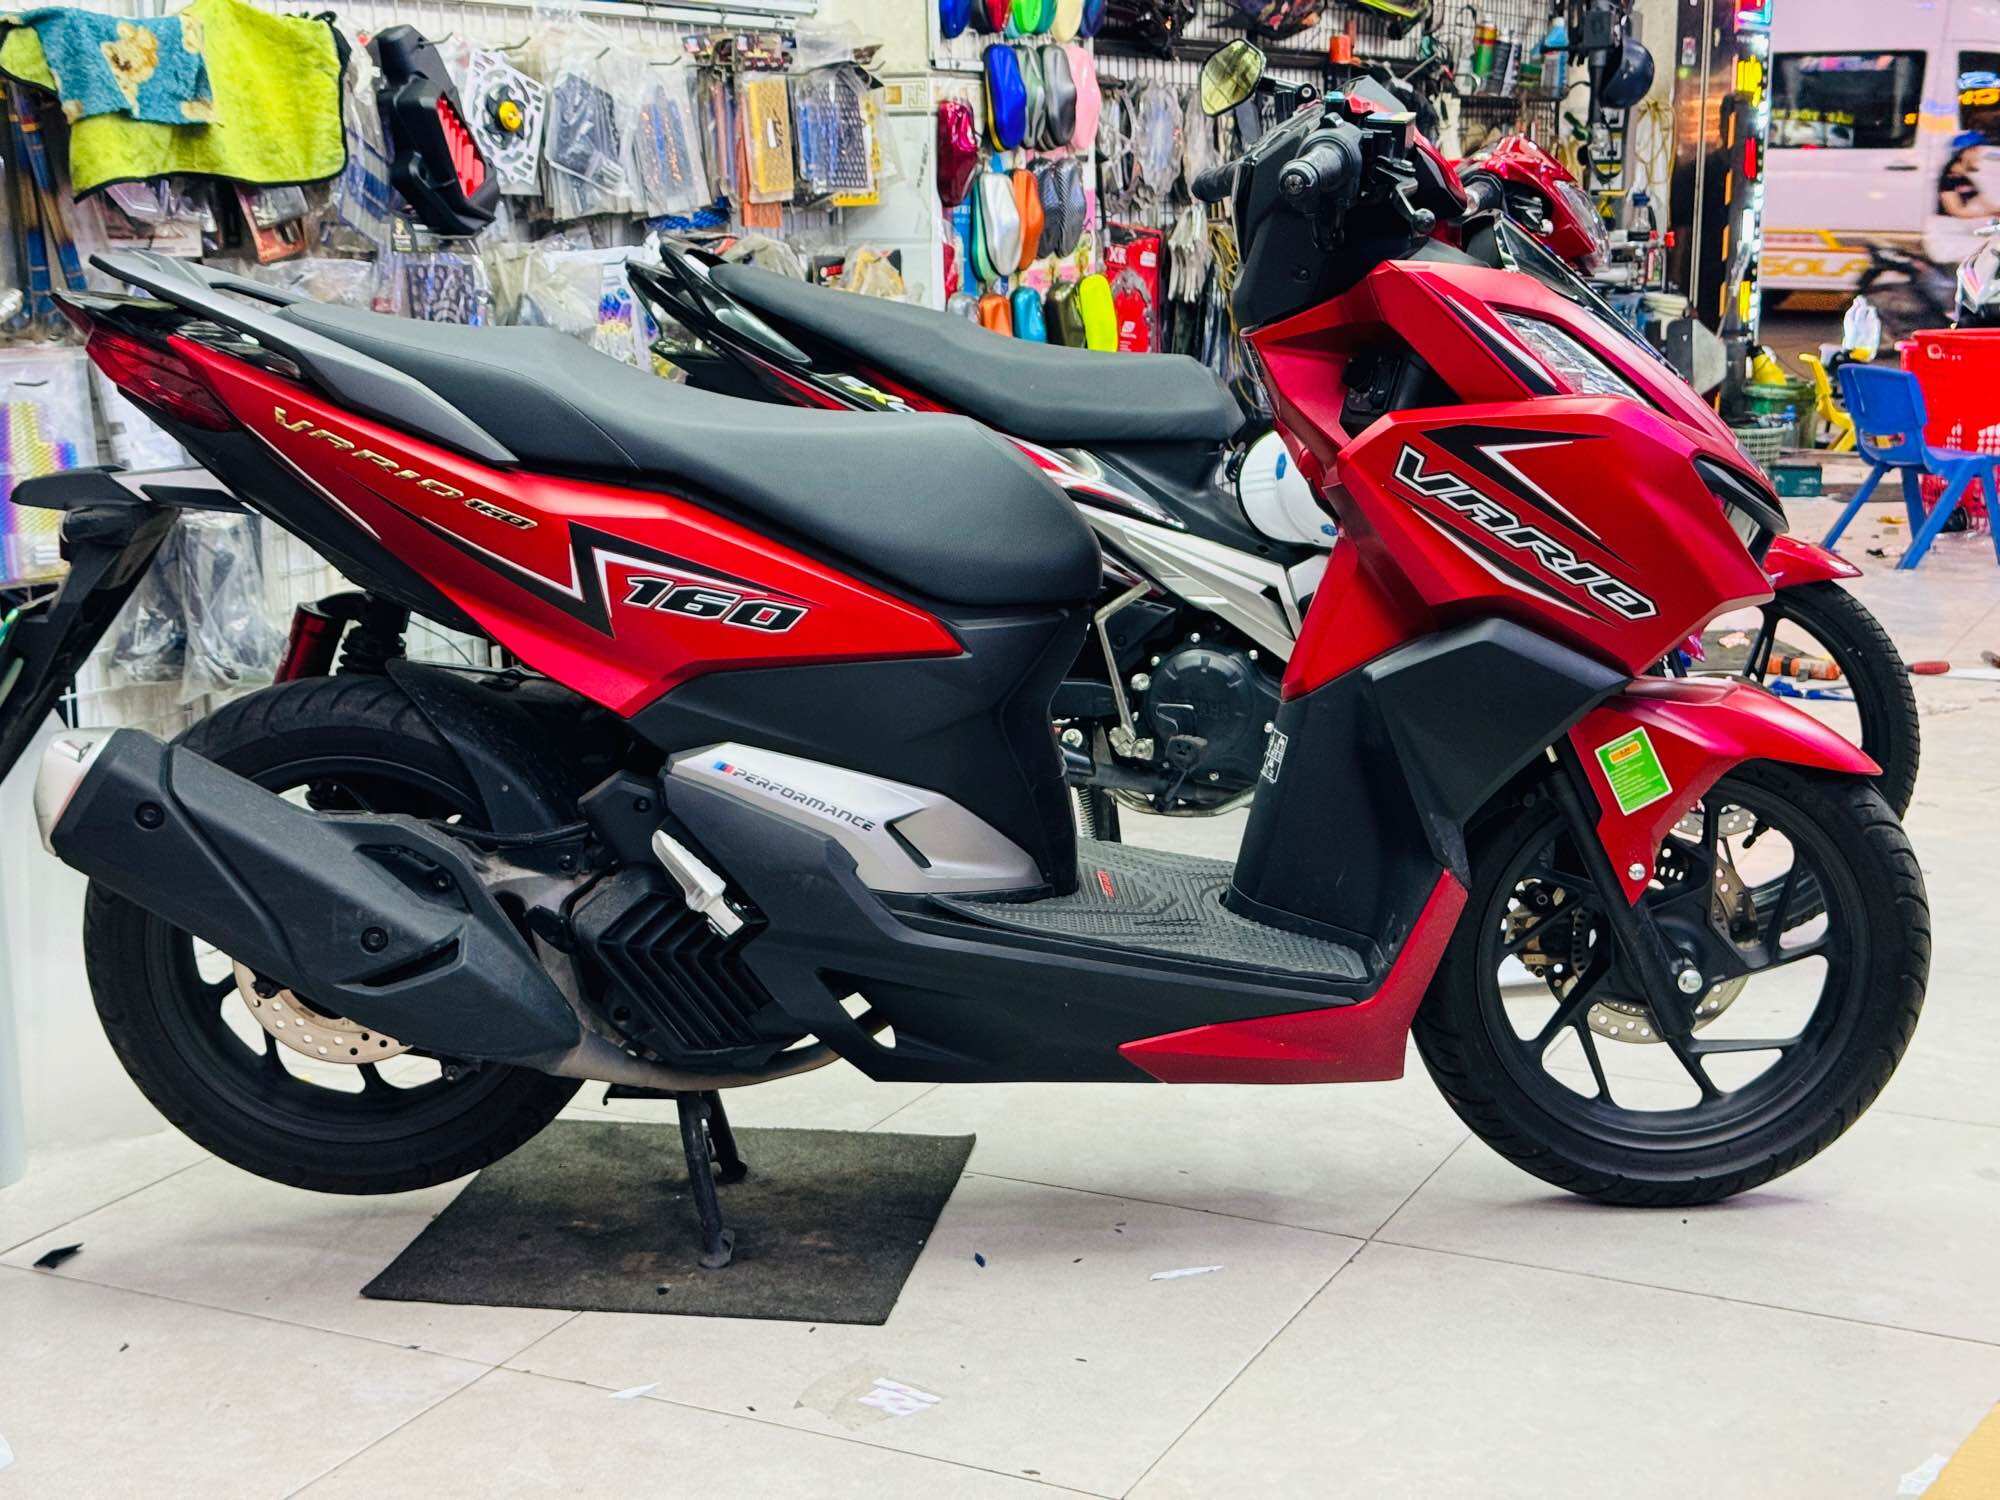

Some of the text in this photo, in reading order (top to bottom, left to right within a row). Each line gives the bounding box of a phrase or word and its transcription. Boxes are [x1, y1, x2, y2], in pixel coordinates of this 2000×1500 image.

[275, 407, 538, 530] VARIO 160
[1394, 444, 1658, 620] VARIO
[624, 575, 809, 633] 160
[733, 768, 876, 832] PERFORMANCE
